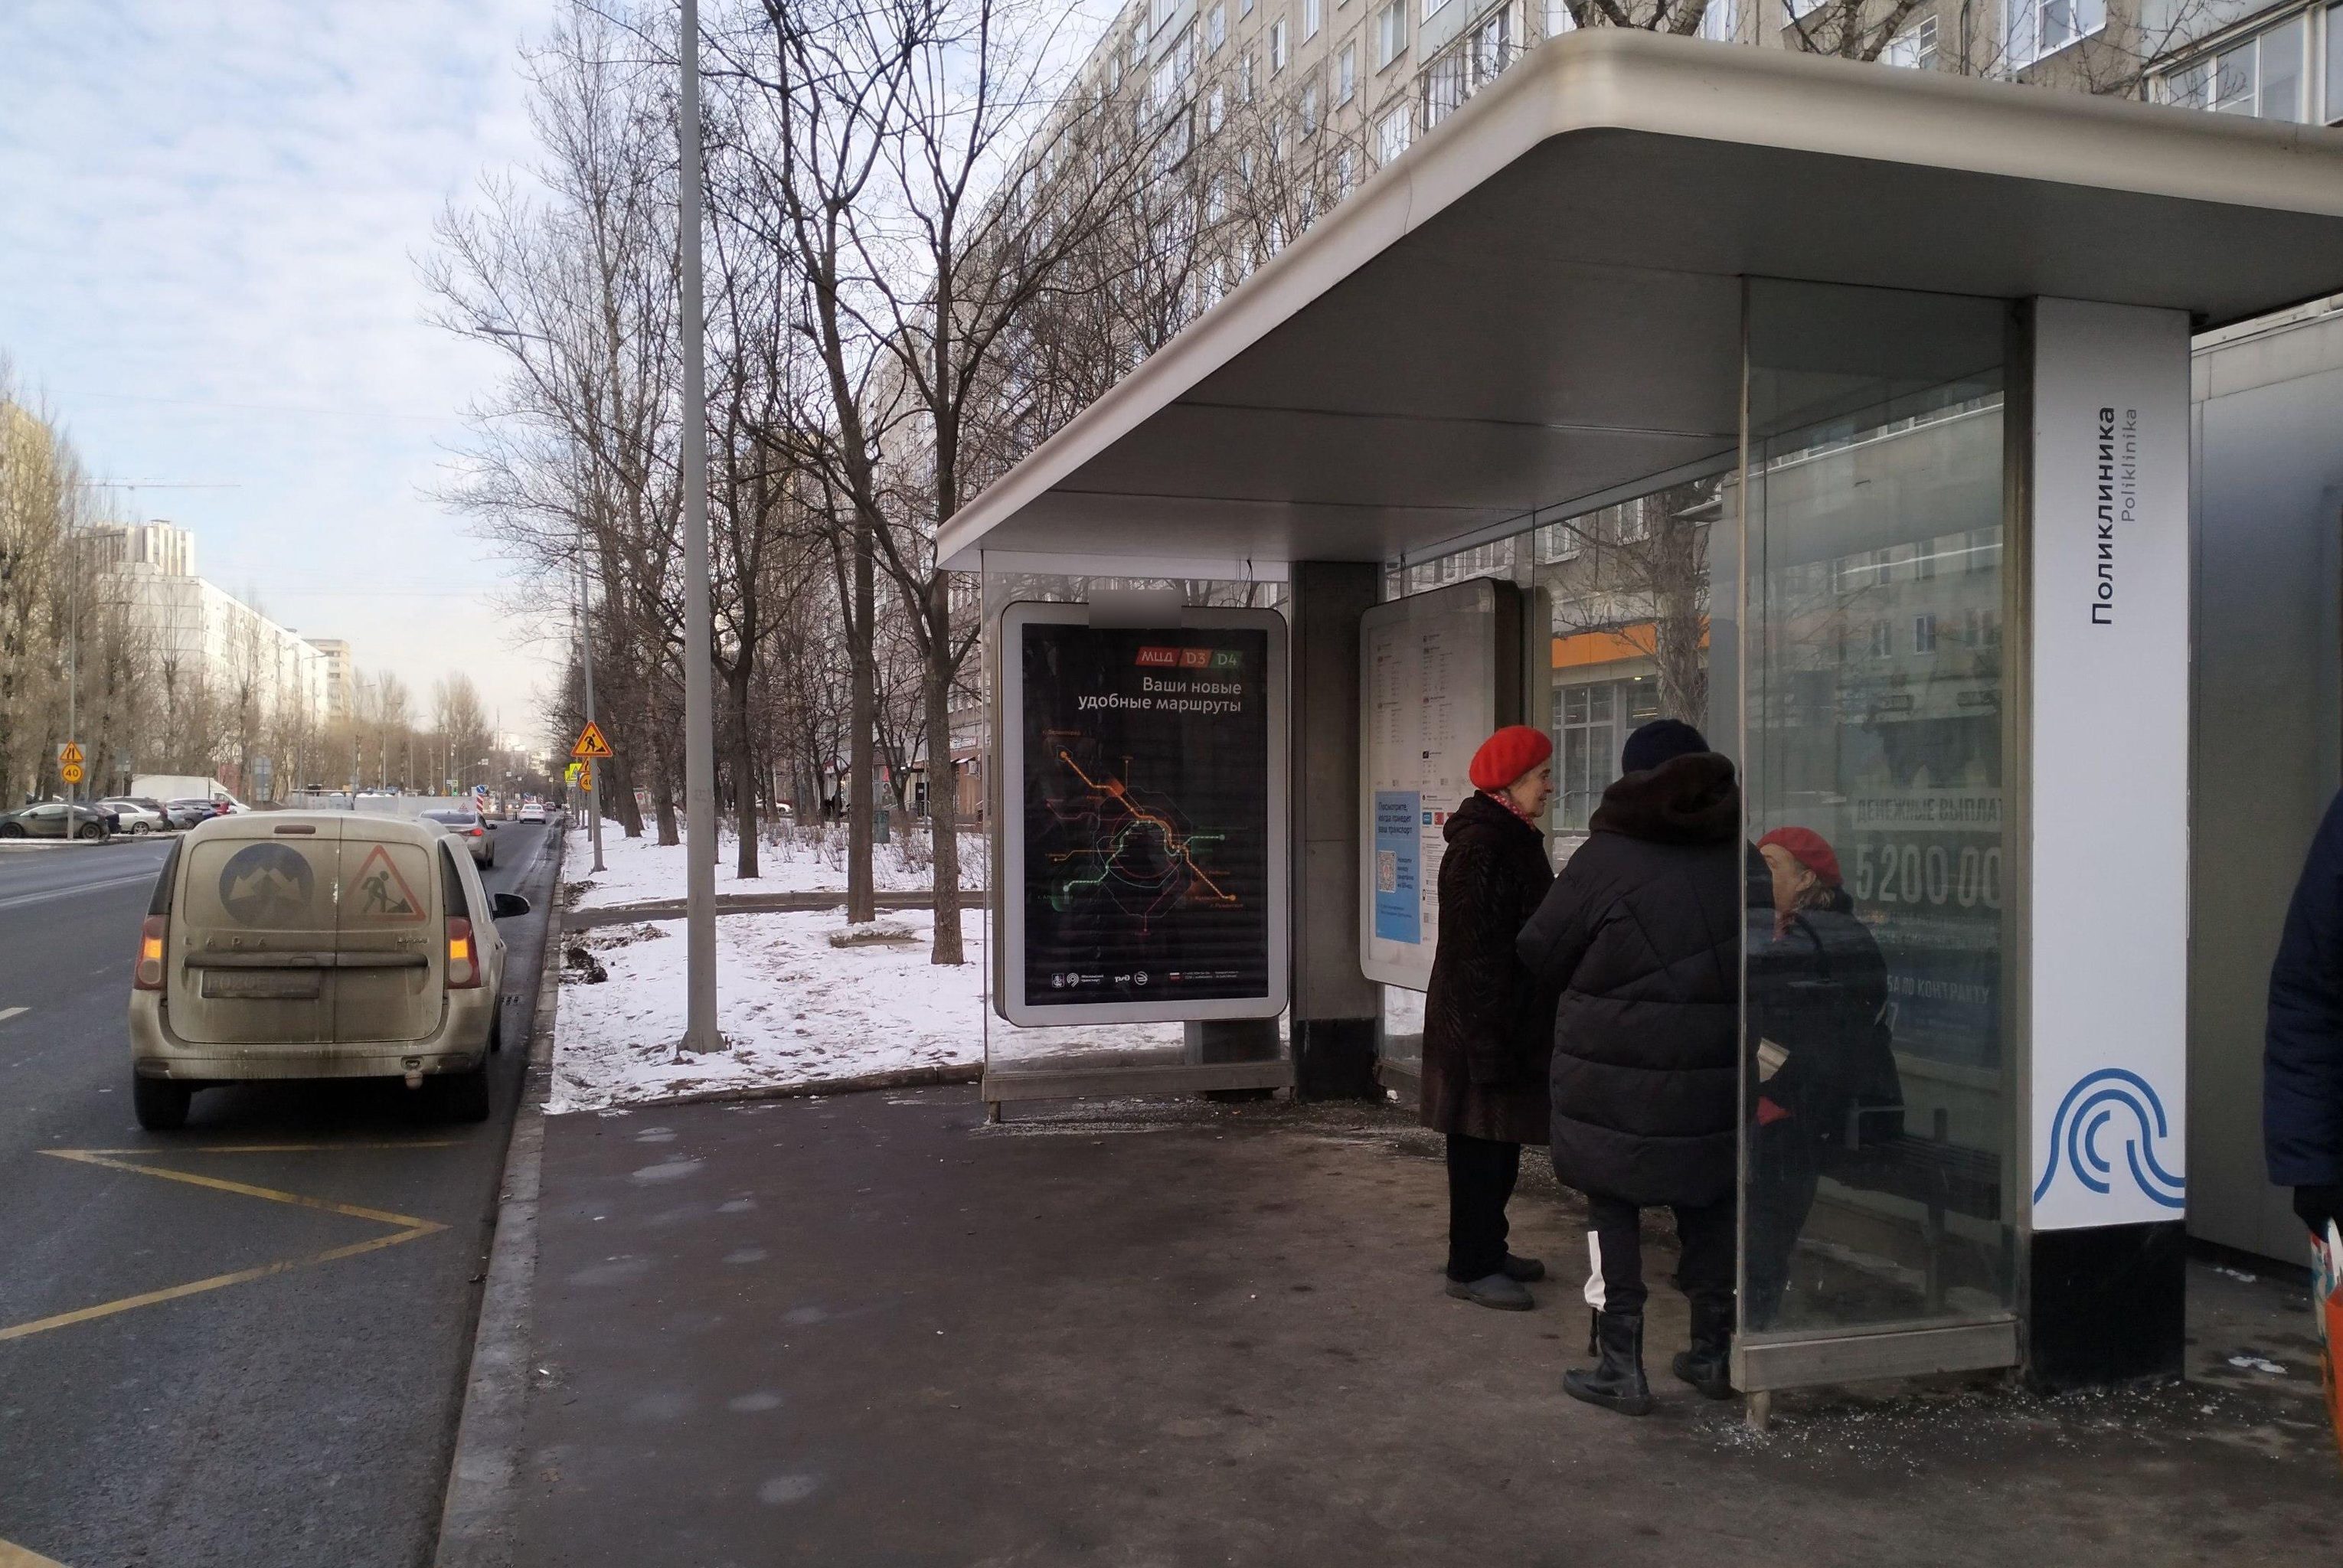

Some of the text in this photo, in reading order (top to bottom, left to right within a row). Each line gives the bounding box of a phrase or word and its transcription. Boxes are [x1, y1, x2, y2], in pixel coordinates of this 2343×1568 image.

[2121, 408, 2137, 522] Poliklinika
[2092, 407, 2115, 625] Поликлиника
[1141, 650, 1238, 666] МЦД D3 D4
[1142, 676, 1242, 695] Ваши новые
[1077, 692, 1242, 715] удобные маршруты
[65, 769, 79, 777] 40
[1857, 799, 1936, 824] ДЕНЕЖНЫЕ
[184, 936, 268, 947] LADA
[1917, 979, 1990, 1004] КОНТРАКТУ
